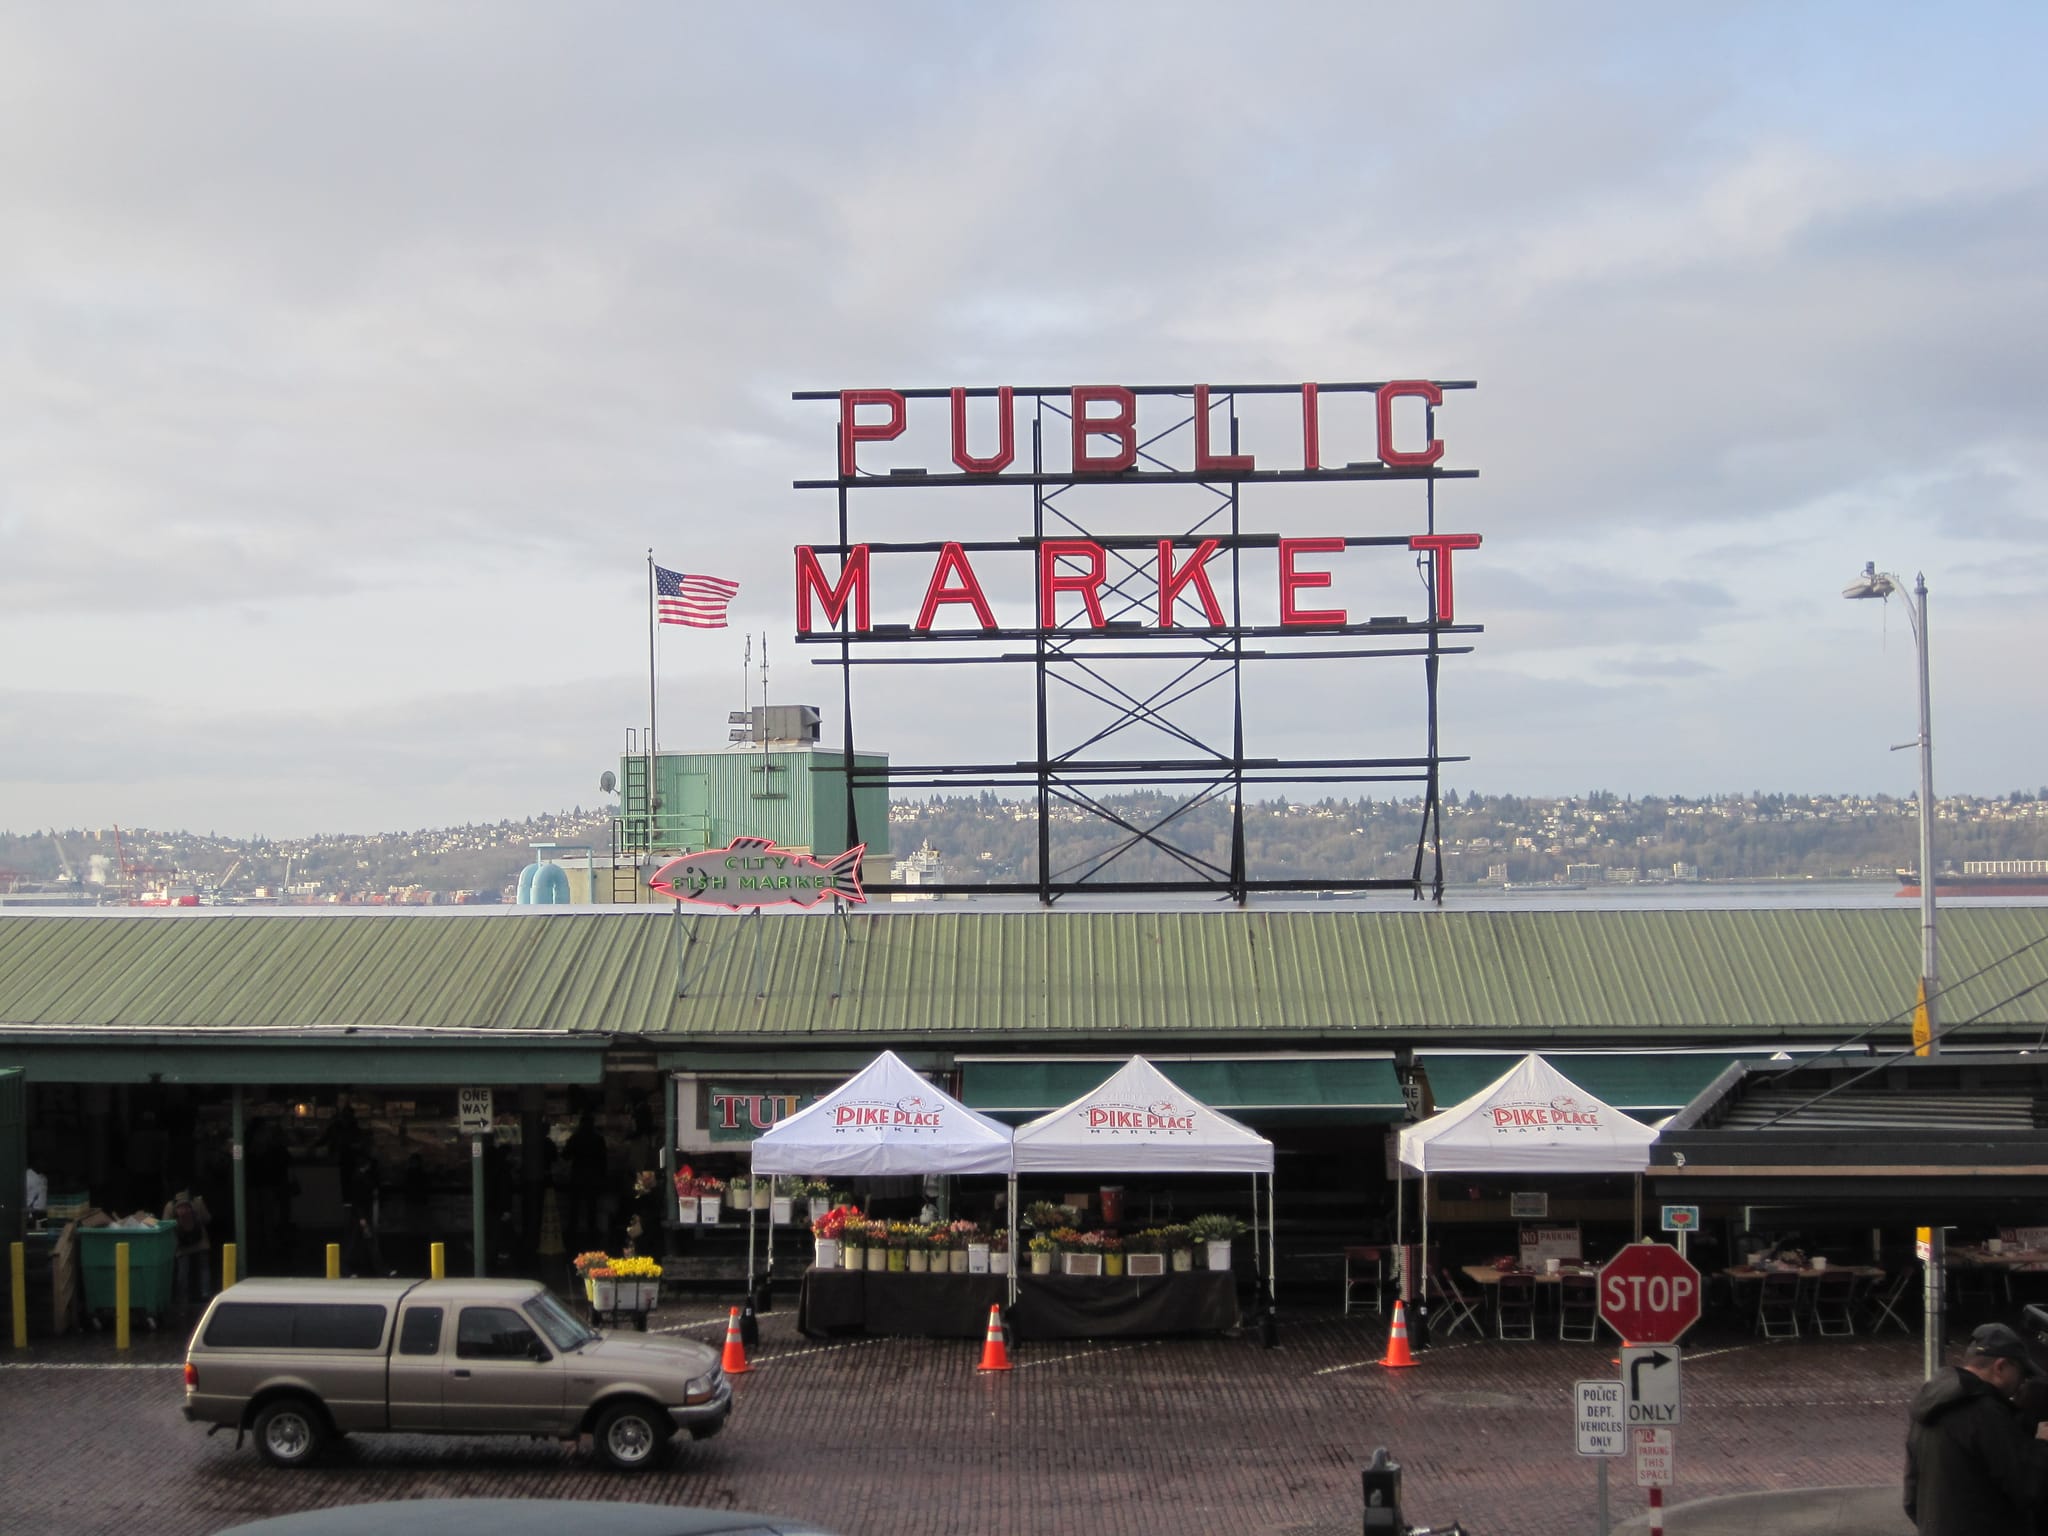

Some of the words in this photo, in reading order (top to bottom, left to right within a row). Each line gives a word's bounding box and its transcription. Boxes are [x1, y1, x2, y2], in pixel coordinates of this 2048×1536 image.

[840, 380, 1446, 476] PUBLIC
[795, 534, 1483, 632] MARKET
[725, 856, 787, 870] CITY
[672, 876, 727, 890] FISH
[738, 875, 840, 889] MARKET
[462, 1090, 488, 1101] ONE
[1401, 1087, 1418, 1098] NE
[462, 1104, 488, 1114] WAY
[836, 1106, 889, 1125] PIKE
[894, 1111, 940, 1126] PLACE
[1090, 1108, 1142, 1127] PIKE
[1147, 1113, 1192, 1128] PLACE
[1493, 1107, 1548, 1126] PIKE
[1551, 1110, 1598, 1125] PLACE
[1521, 1231, 1537, 1244] NO
[1606, 1275, 1693, 1312] STOP
[1583, 1389, 1617, 1401] POLICE
[1587, 1406, 1615, 1418] DEPT.
[1628, 1404, 1676, 1420] ONLY
[1580, 1421, 1622, 1432] VEHICLES
[1590, 1436, 1612, 1447] ONLY
[1639, 1446, 1669, 1456] PARKING
[1644, 1458, 1665, 1468] THIS
[1639, 1469, 1669, 1480] SPACE
